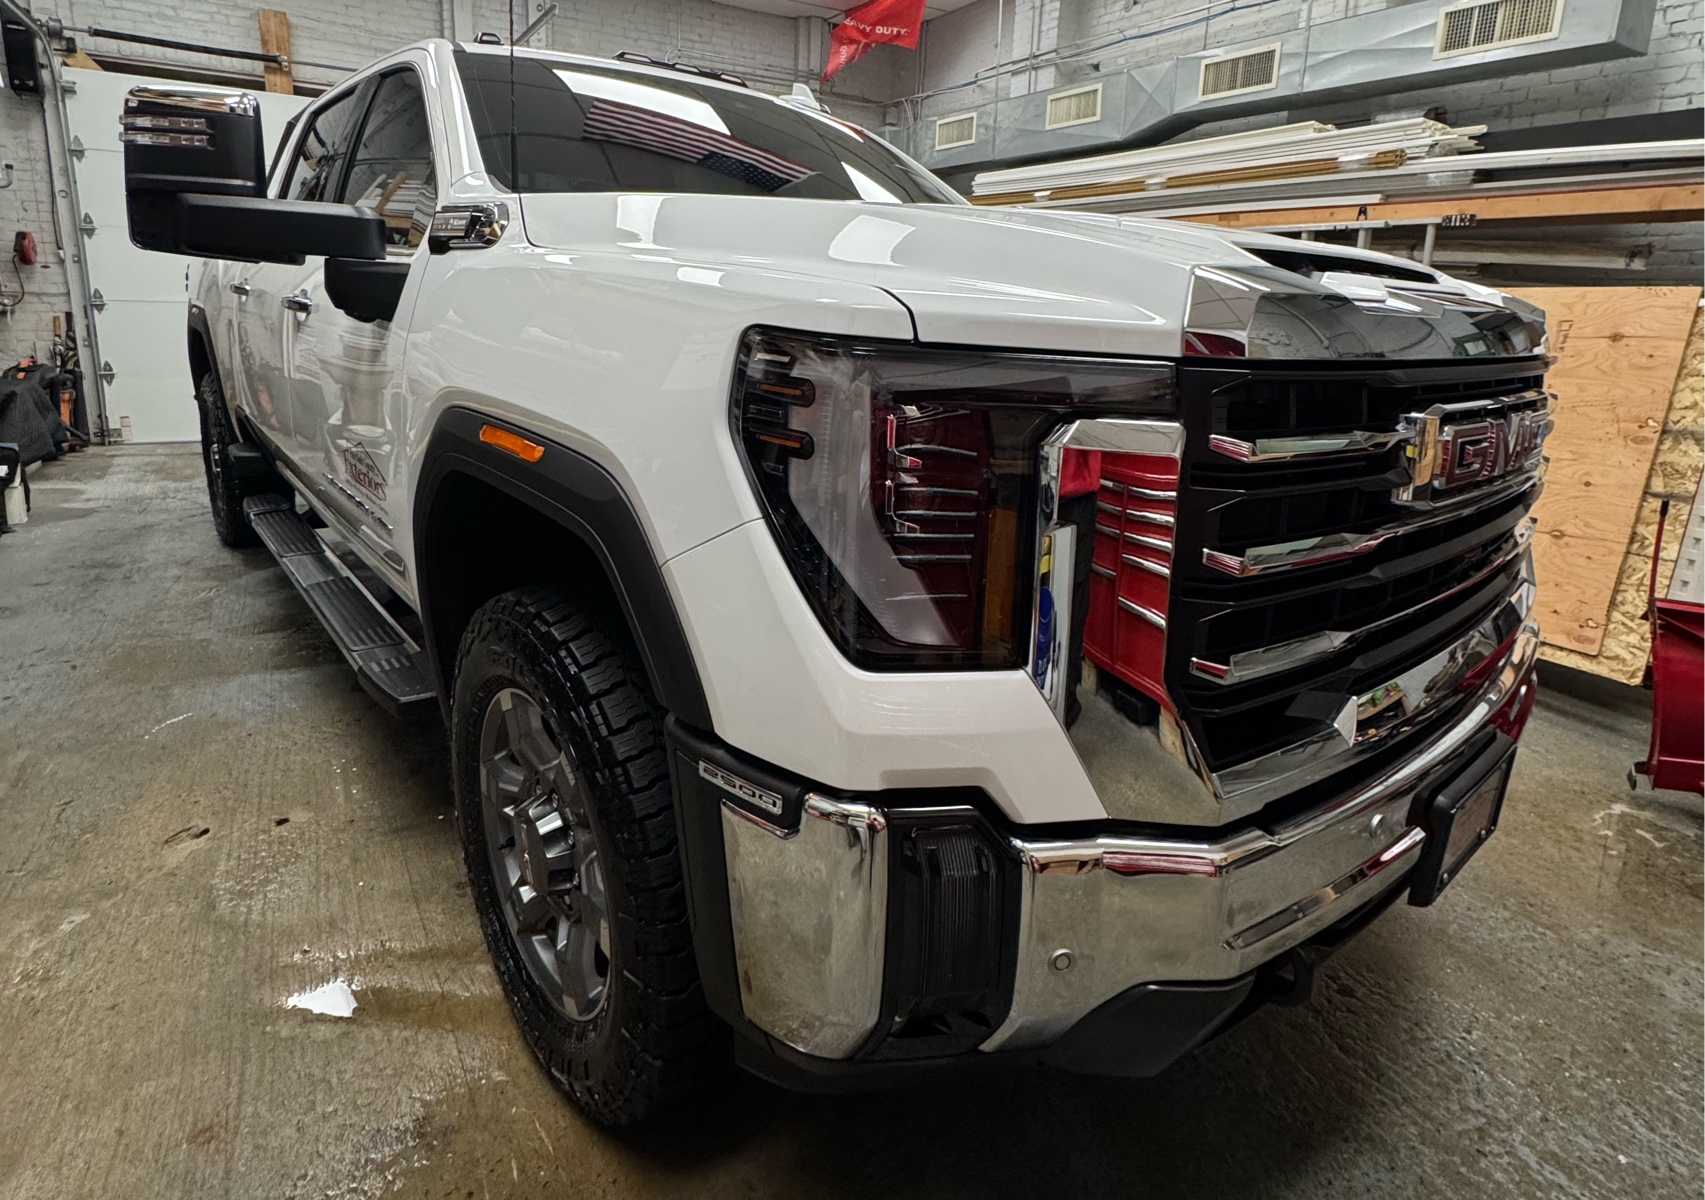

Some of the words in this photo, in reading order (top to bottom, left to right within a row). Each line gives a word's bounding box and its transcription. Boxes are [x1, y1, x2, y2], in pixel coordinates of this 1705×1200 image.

[844, 17, 872, 33] EAVY
[1436, 411, 1549, 488] GMC
[702, 764, 778, 809] 2500
